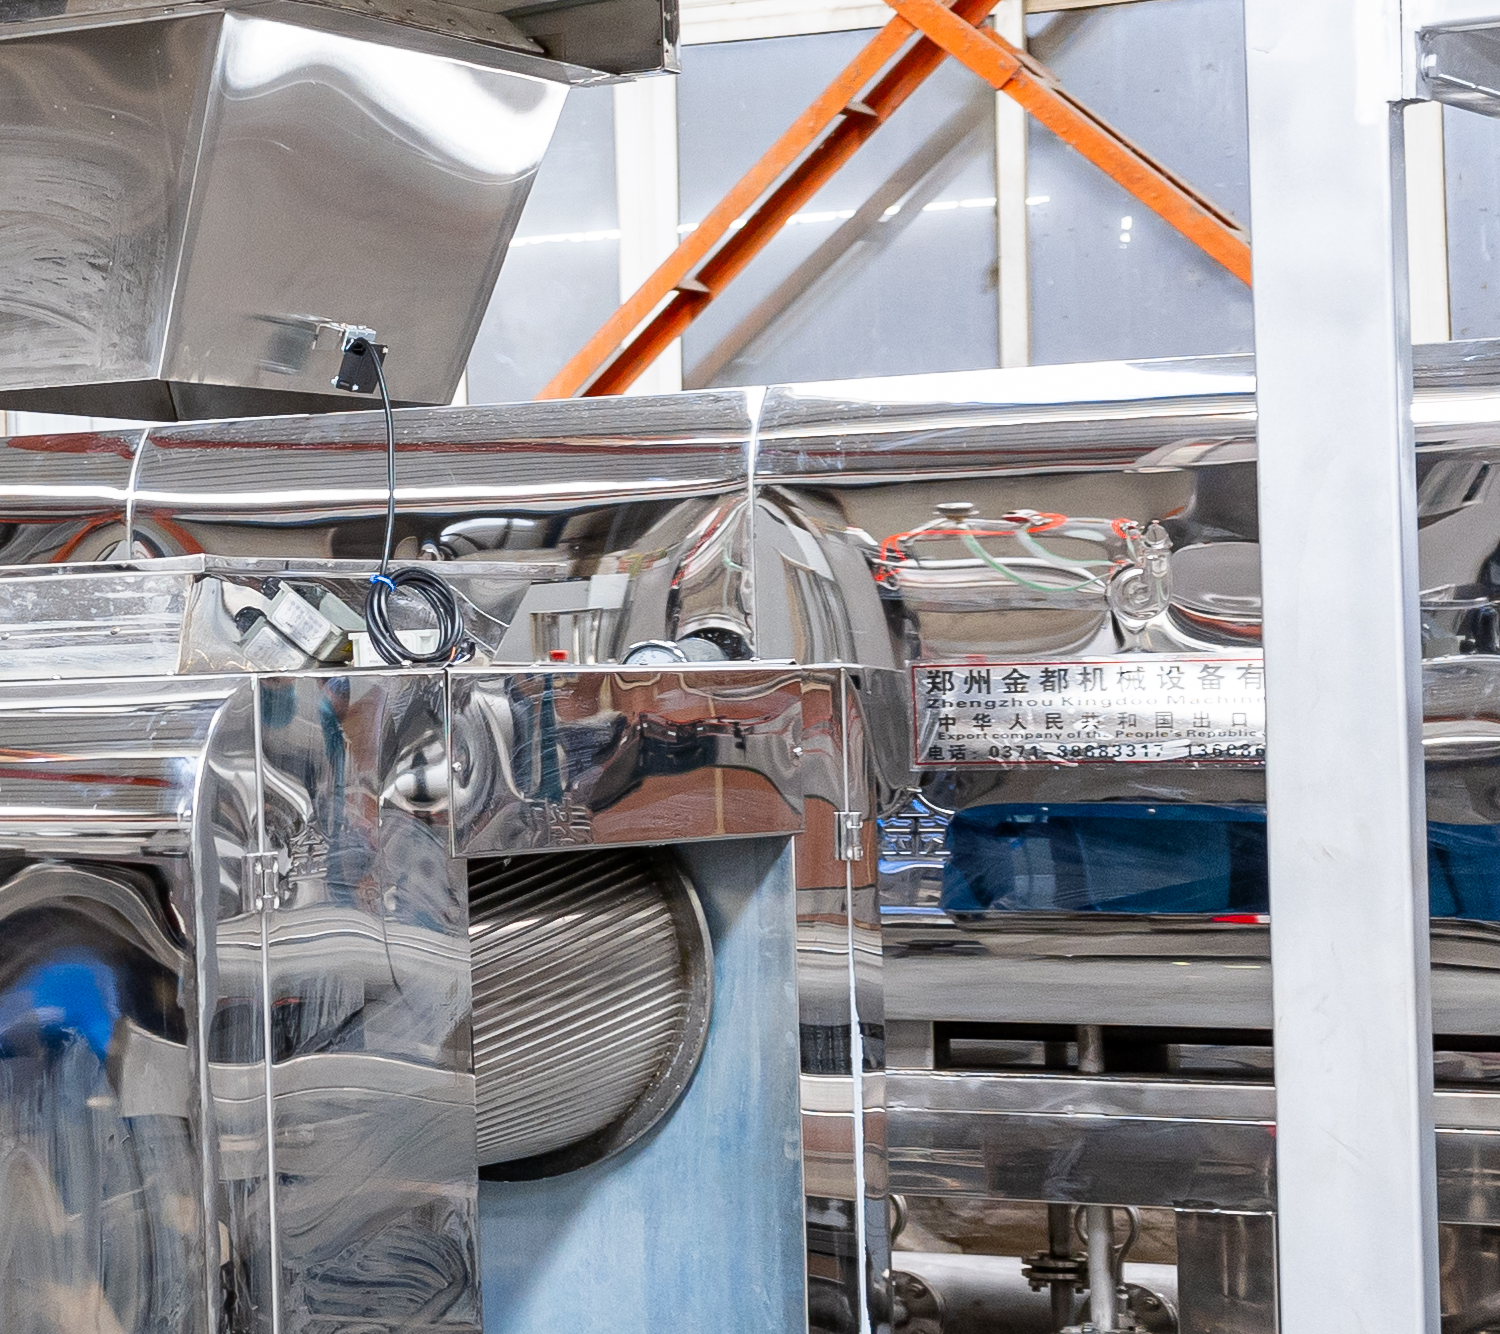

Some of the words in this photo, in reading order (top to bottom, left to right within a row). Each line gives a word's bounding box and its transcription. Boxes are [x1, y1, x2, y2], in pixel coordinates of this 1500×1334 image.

[926, 664, 1265, 695] 郑州金都机械设备有
[926, 697, 1053, 710] Zhengzhou
[1061, 696, 1157, 708] Kingdoo
[938, 711, 1248, 733] 中华人民共和国出口
[938, 732, 988, 741] Export
[992, 732, 1062, 741] company
[1067, 731, 1081, 739] of
[1115, 729, 1182, 739] People's
[1186, 729, 1257, 739] Republic
